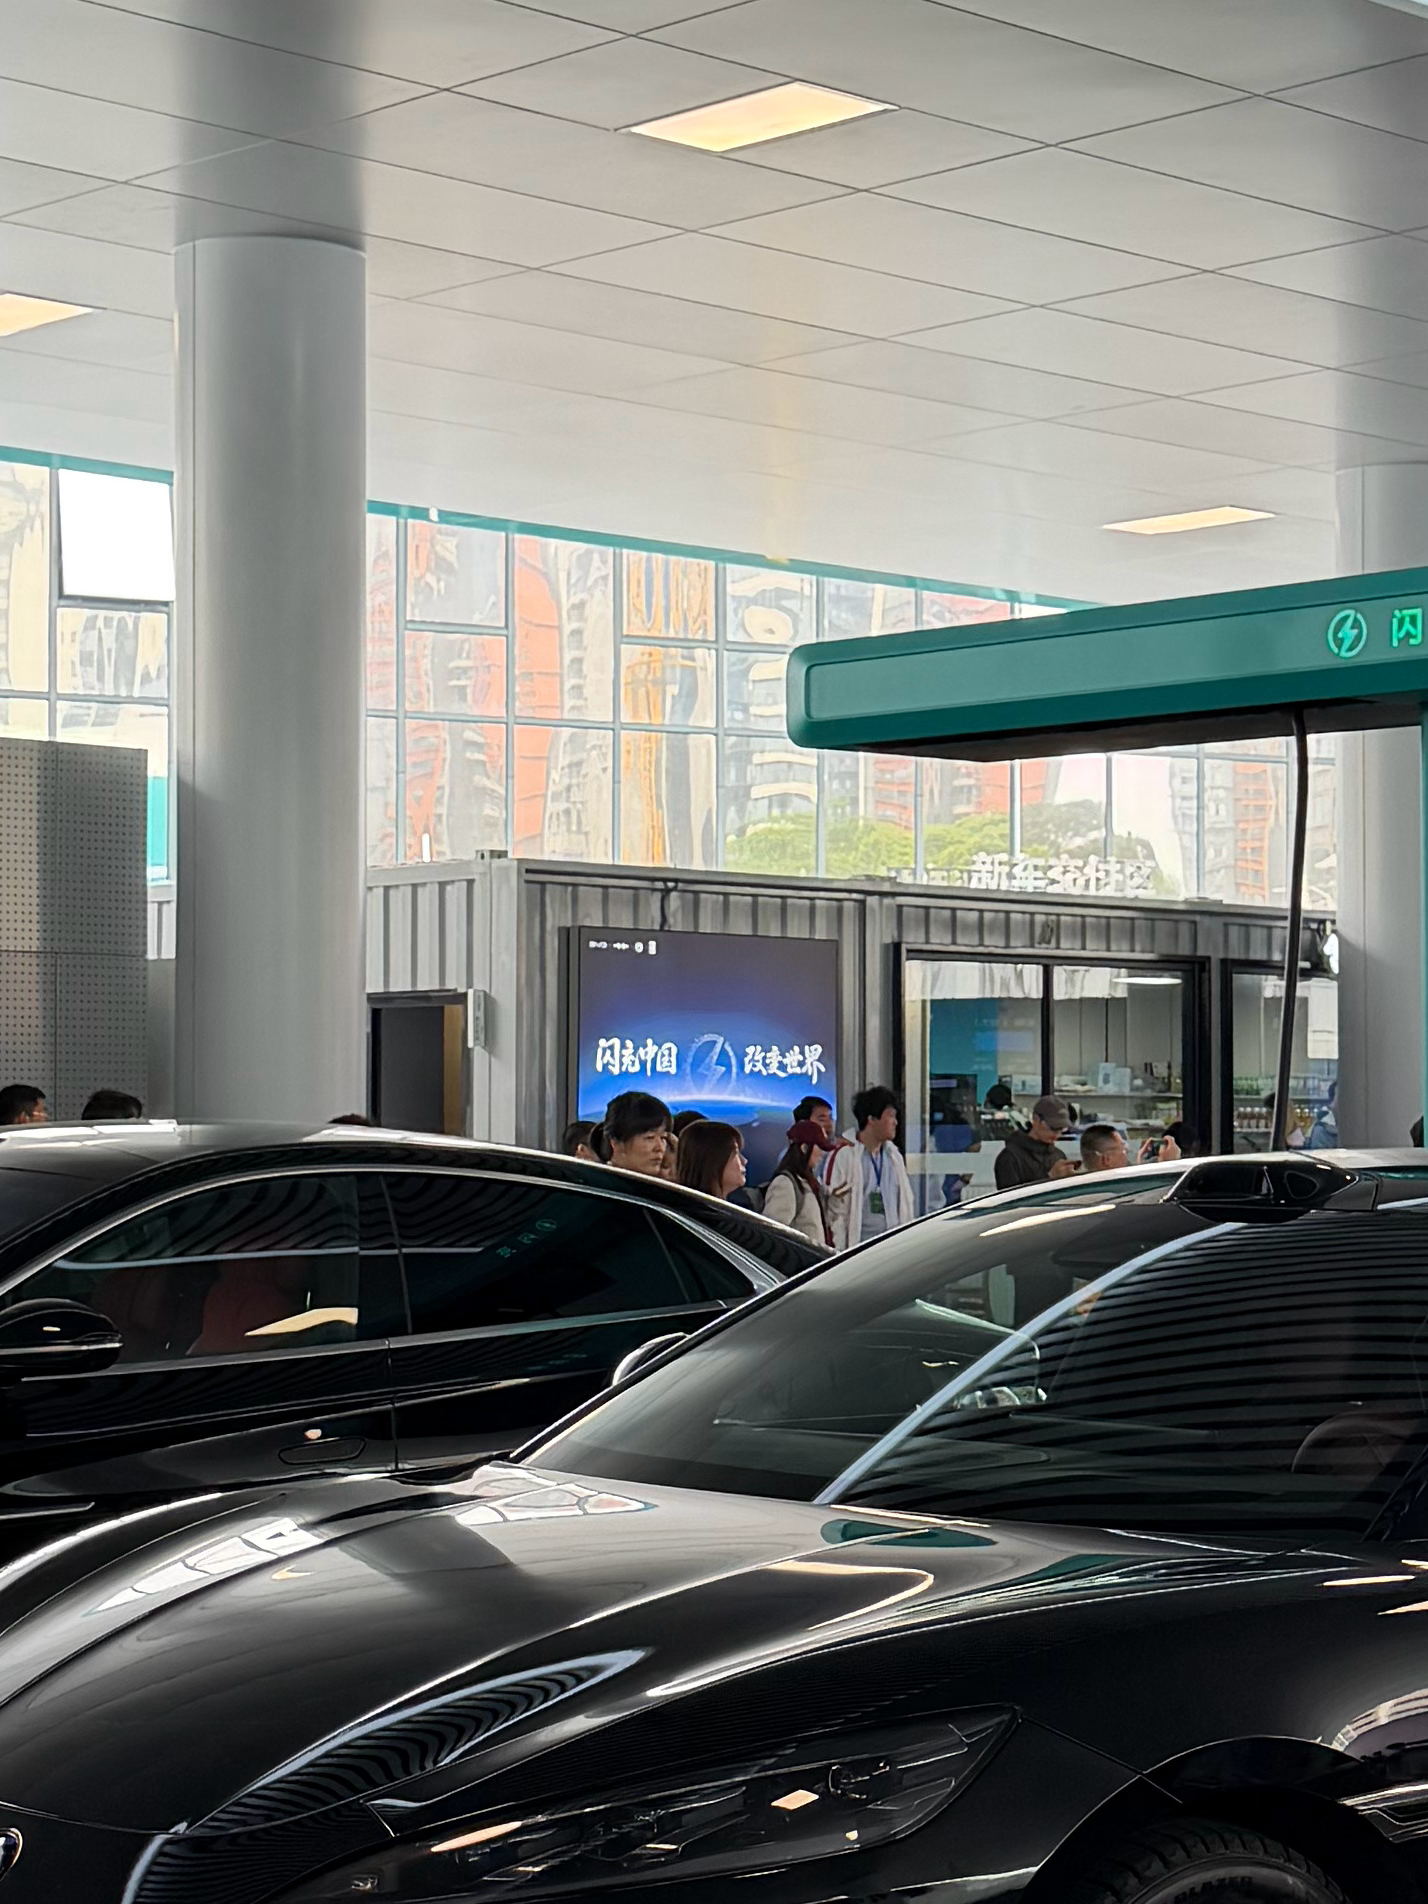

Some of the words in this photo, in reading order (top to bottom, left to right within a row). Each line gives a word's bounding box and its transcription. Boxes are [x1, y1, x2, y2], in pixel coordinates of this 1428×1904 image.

[595, 1037, 678, 1077] 闪充中国
[744, 1043, 826, 1085] 改变世界
